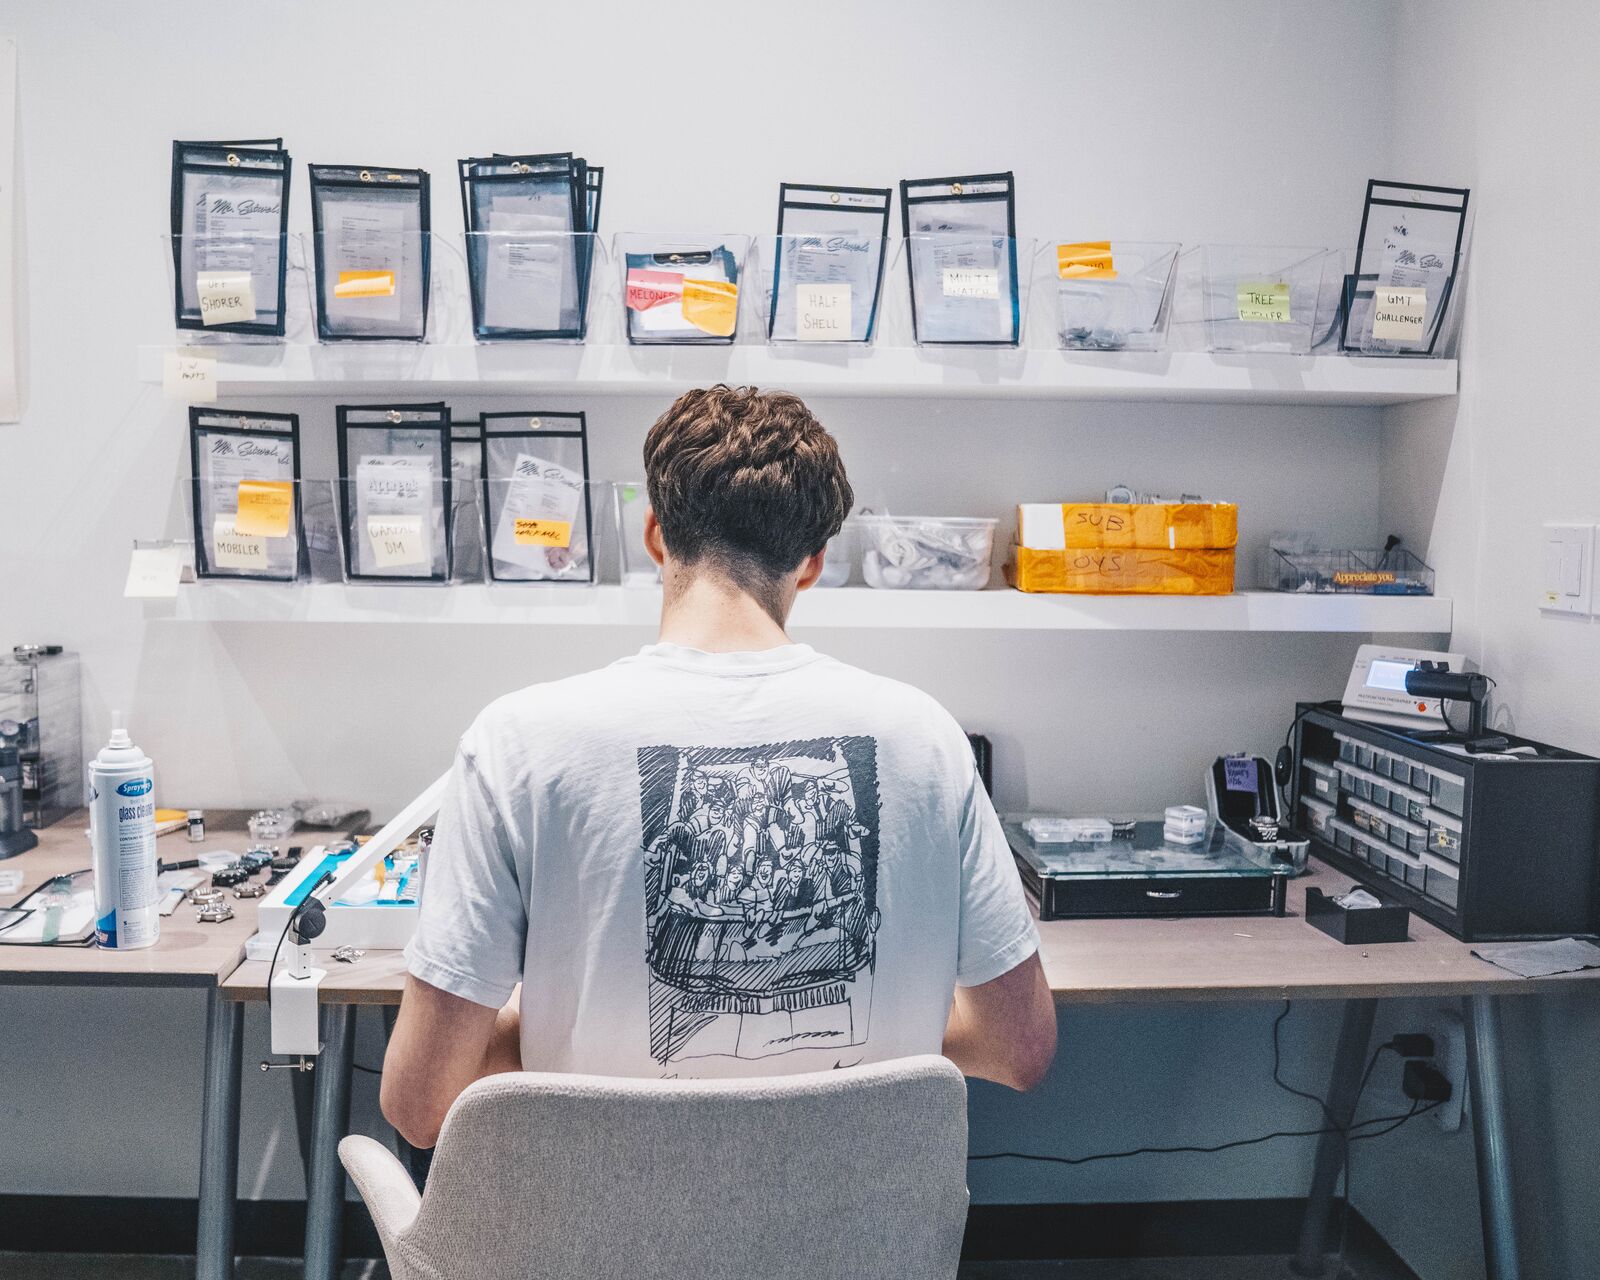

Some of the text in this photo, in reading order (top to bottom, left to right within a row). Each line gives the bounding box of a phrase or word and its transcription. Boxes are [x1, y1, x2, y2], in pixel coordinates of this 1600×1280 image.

[201, 296, 243, 312] SHORER
[809, 294, 839, 309] HALF
[1247, 292, 1275, 305] TREE
[1387, 295, 1412, 306] GMT
[803, 313, 839, 330] SHELL
[1375, 312, 1423, 325] CHALLENGER
[1077, 512, 1125, 532] SUB
[217, 542, 260, 555] MOBILER
[1073, 554, 1121, 572] OYS
[1335, 571, 1378, 584] Appreciate
[119, 806, 136, 823] glass
